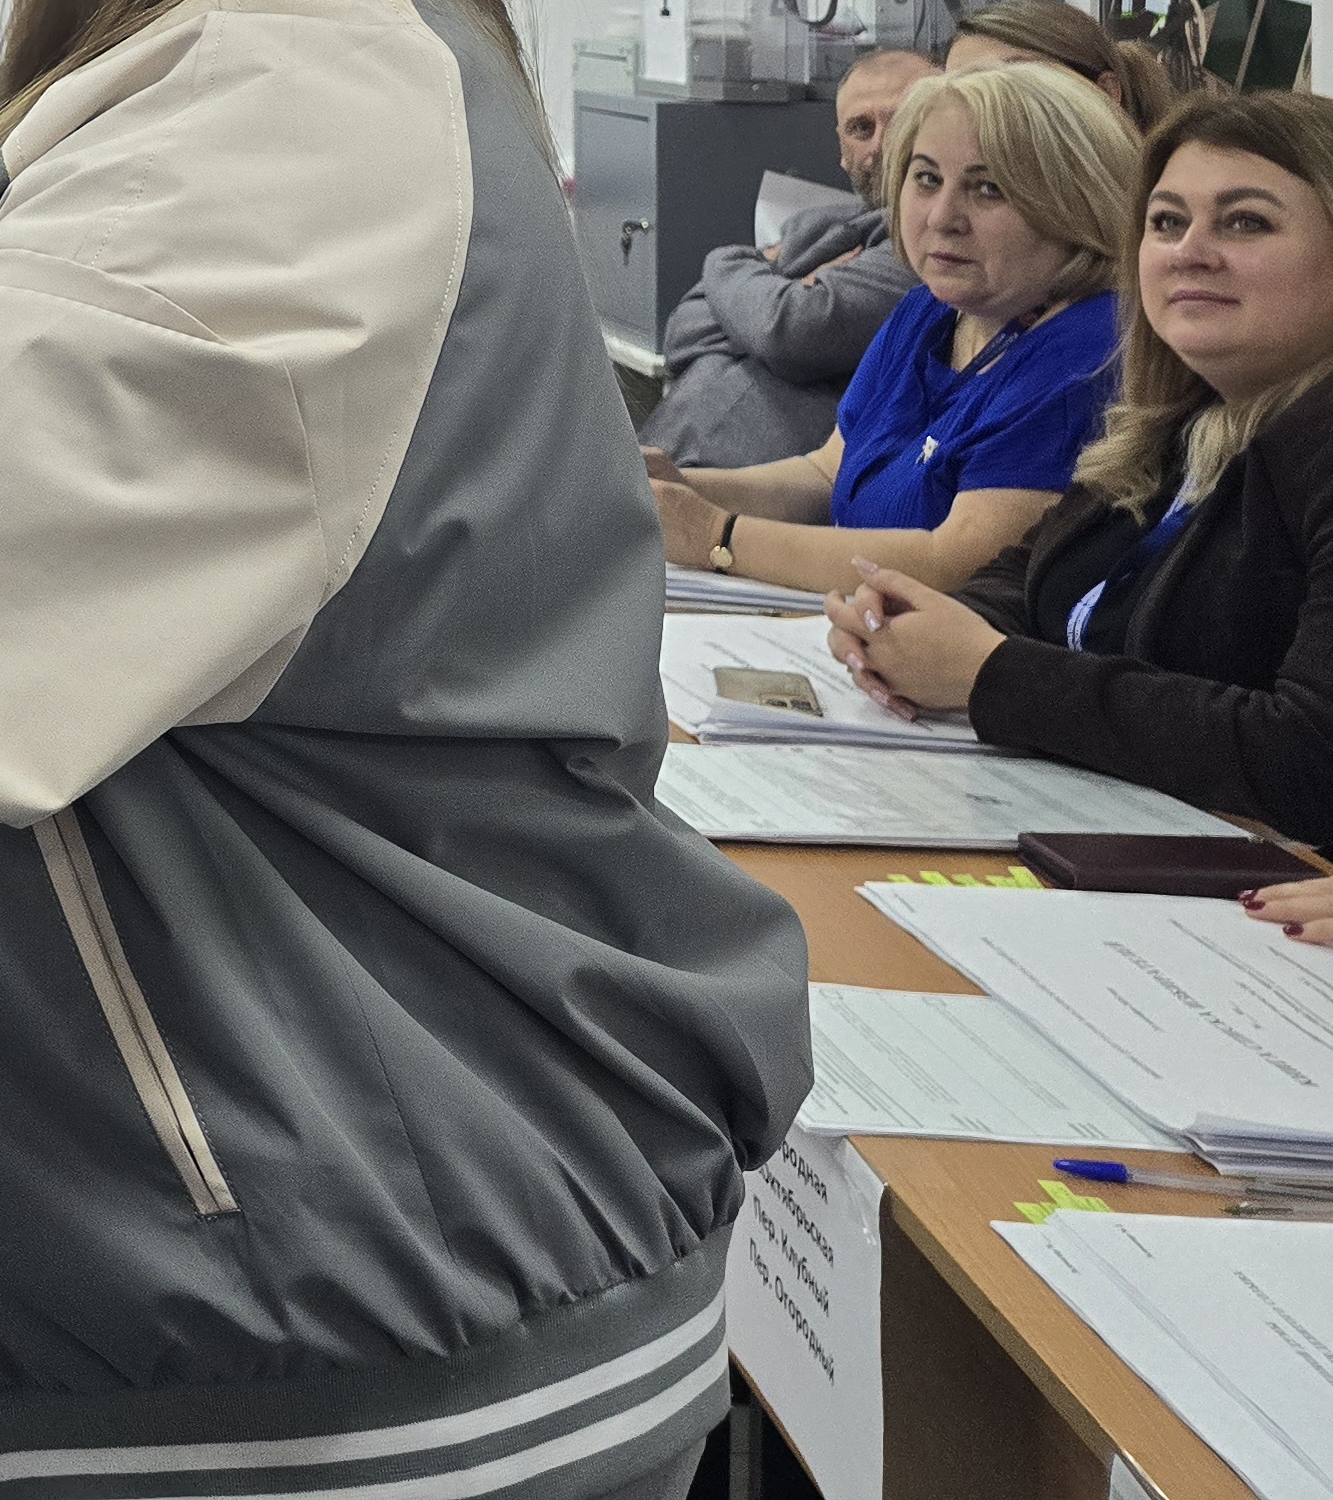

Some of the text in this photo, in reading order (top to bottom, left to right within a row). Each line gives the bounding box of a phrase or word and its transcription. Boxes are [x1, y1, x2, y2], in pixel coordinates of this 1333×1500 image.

[777, 1140, 828, 1204] родная
[781, 1229, 829, 1317] Клубный
[775, 1276, 835, 1386] Огородный
